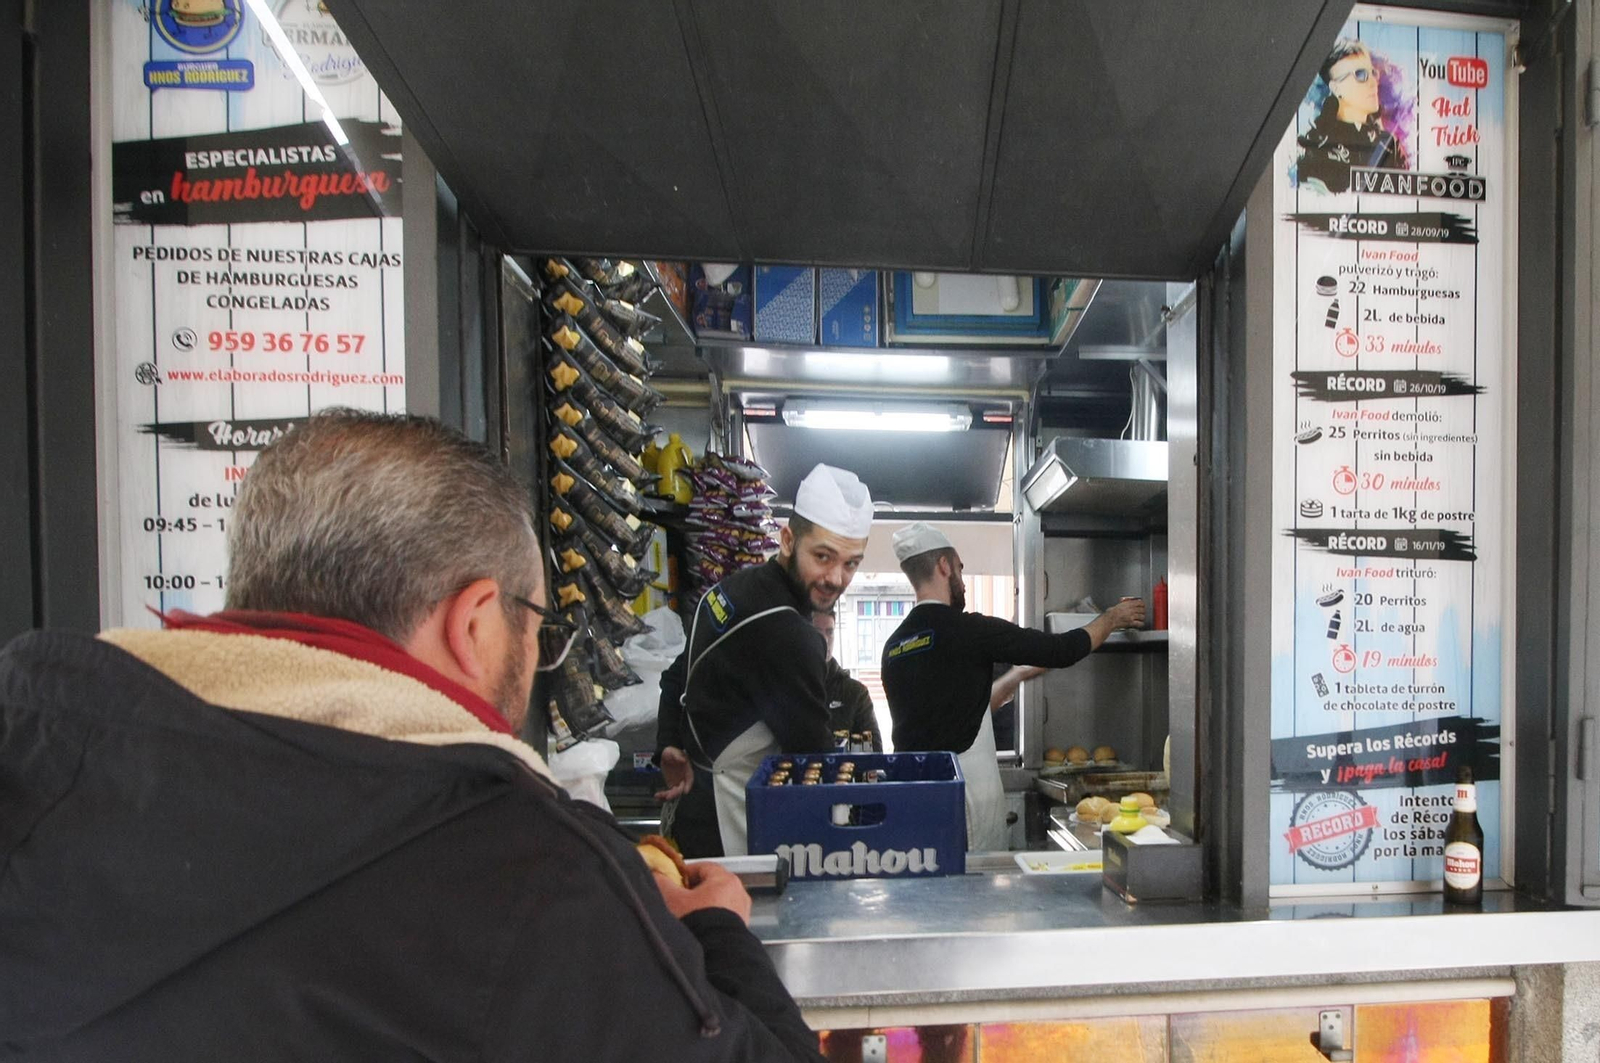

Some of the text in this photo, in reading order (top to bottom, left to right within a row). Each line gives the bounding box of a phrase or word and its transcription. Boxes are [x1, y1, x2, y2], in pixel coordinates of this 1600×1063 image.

[184, 69, 248, 84] RODRIGUEZ
[1432, 97, 1471, 118] Hat
[1431, 125, 1480, 147] Trick
[185, 145, 336, 169] ESPECIALISTAS
[140, 168, 390, 210] en hamburguesa
[1329, 214, 1449, 239] RÉCORD 28/09/19
[133, 246, 401, 268] PEDIDOS DE NUESTRAS CAJAS
[1361, 249, 1418, 261] Ivan Food
[177, 270, 358, 288] DE HAMBURGUESAS
[1339, 264, 1439, 281] pulverizó y tragó:
[1348, 281, 1460, 300] 22 Hamburguesas
[207, 295, 330, 311] CONGELADAS
[1388, 312, 1403, 323] de
[1406, 314, 1445, 325] bebida
[208, 331, 365, 354] 959 36 76 57
[1365, 335, 1442, 355] 33 minutos
[167, 368, 404, 386] www.elaboradosrodriguez.com
[1326, 373, 1446, 394] RÉCORD 26/10/19
[1332, 409, 1442, 422] Ivan Food demolió:
[208, 420, 294, 446] Horar
[1328, 426, 1478, 444] 25 Perritos (sin ingredientes)
[1374, 450, 1433, 462] sin bebida
[225, 467, 248, 480] IN
[1361, 473, 1441, 491] 30 minutos
[189, 493, 235, 507] de lu
[1330, 506, 1475, 523] 1 tarta de 1kg de postre
[143, 517, 197, 532] 09:45
[1328, 532, 1446, 550] RÉCORD 16/11/19
[1336, 567, 1437, 578] Ivan Food trituró:
[144, 575, 195, 590] 10:00
[1355, 594, 1426, 606] 20 Perritos
[1381, 622, 1395, 633] de
[1398, 624, 1426, 636] agua
[1362, 650, 1438, 668] 19 minutos
[1335, 682, 1445, 694] 1 tableta de turrón
[1324, 700, 1456, 713] de chocolate de postre
[1306, 730, 1457, 760] Supera los Récords
[1321, 768, 1331, 784] y
[1388, 756, 1405, 774] la
[1408, 751, 1448, 772] casa!
[1300, 812, 1364, 842] RECORD
[1391, 812, 1408, 824] de
[1384, 826, 1446, 840] los sába
[775, 840, 940, 877] Mahou
[1374, 844, 1444, 861] por la ma
